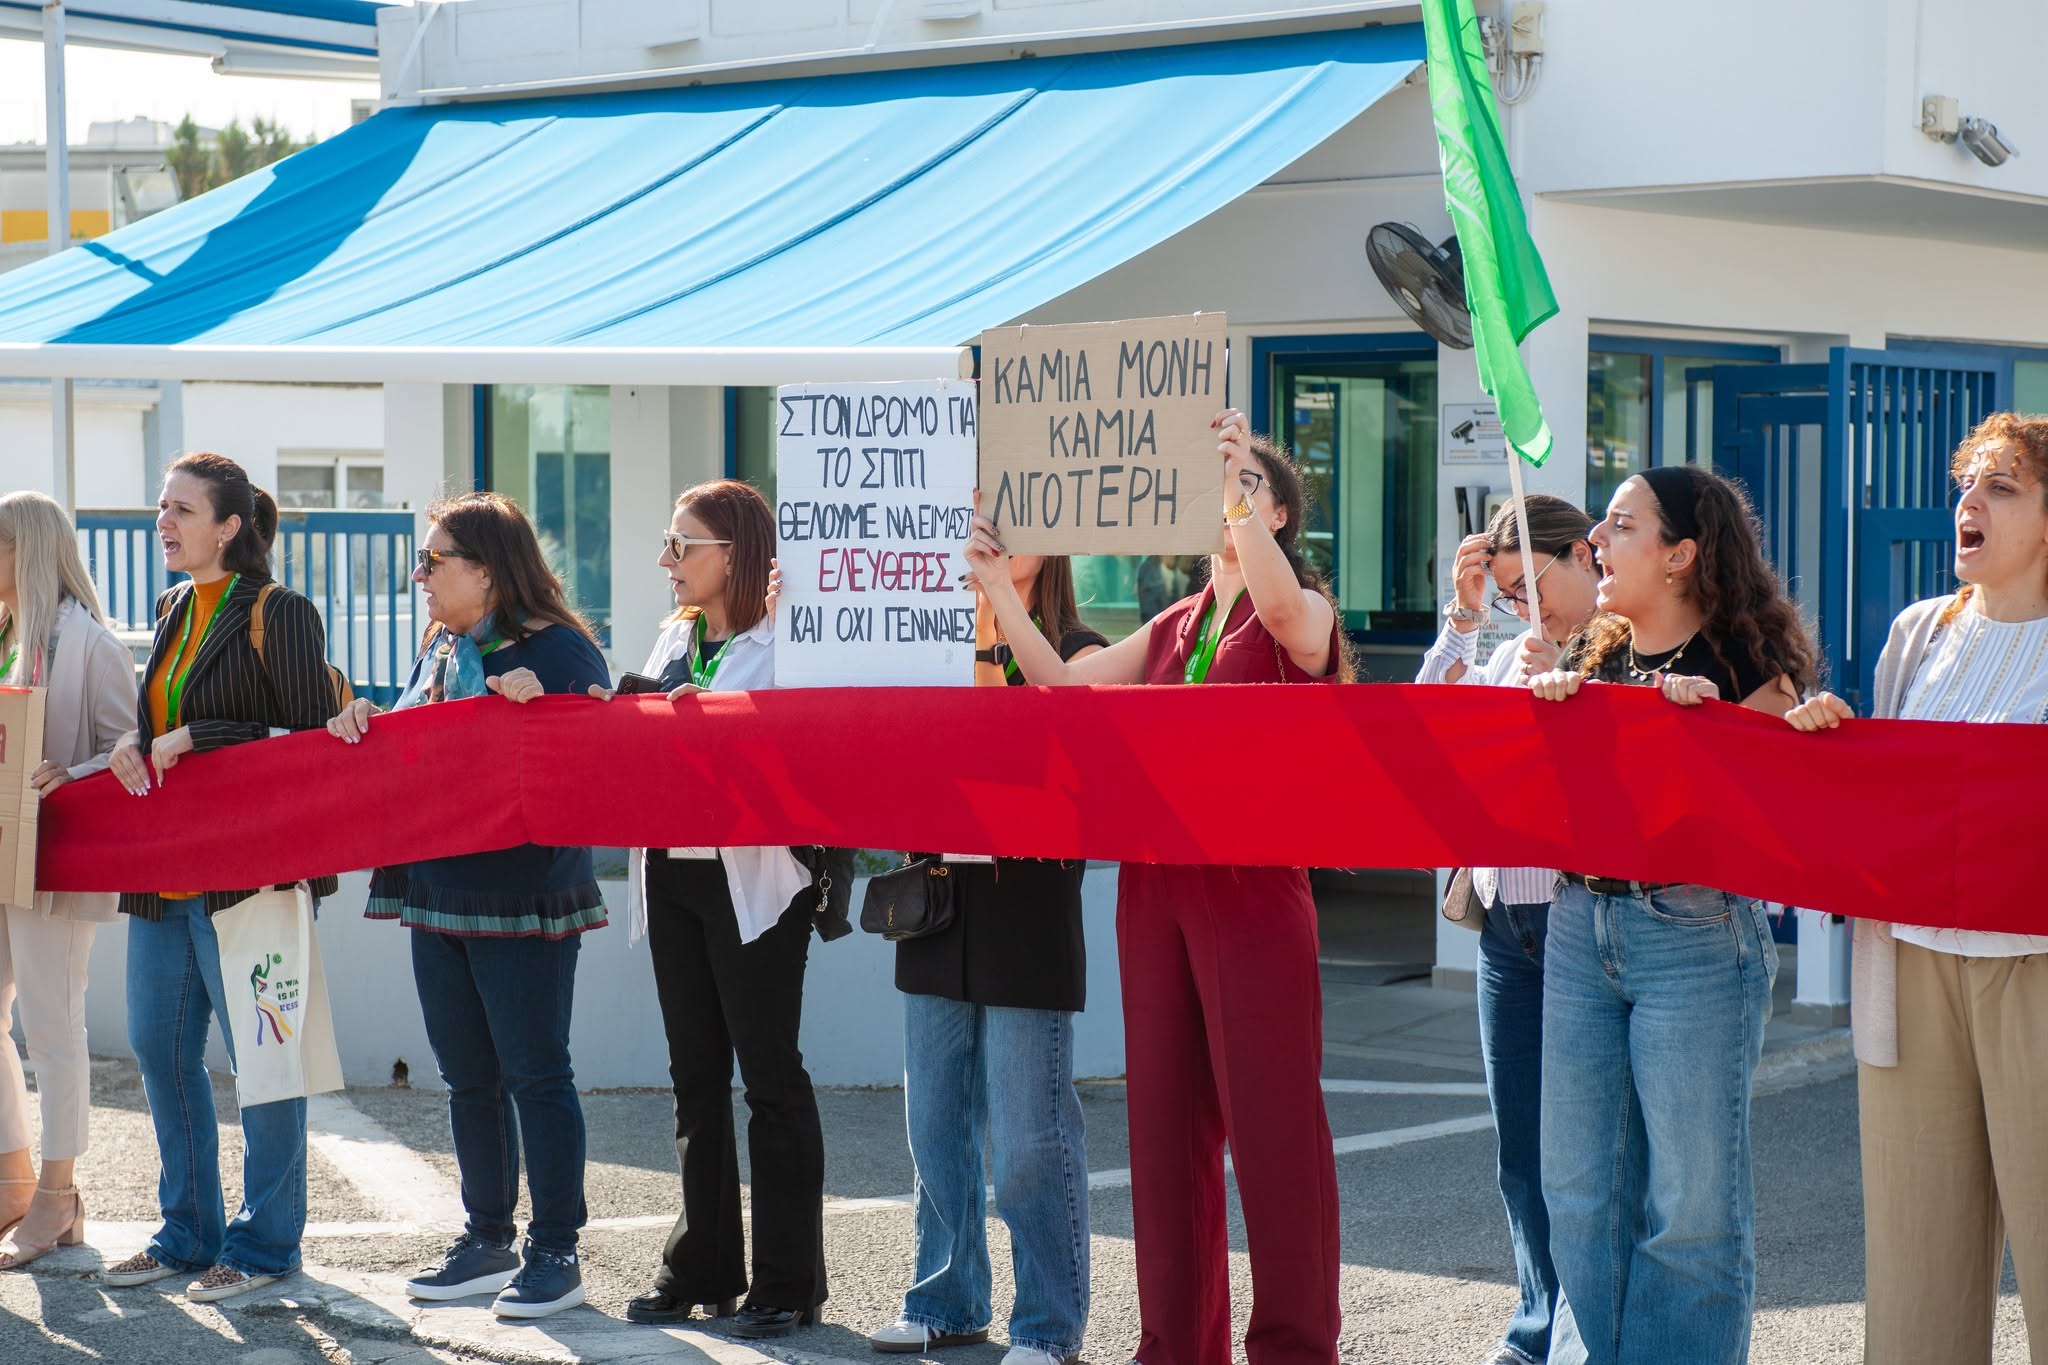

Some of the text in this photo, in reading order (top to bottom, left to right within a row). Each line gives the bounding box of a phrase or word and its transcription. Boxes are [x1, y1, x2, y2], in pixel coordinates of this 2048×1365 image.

[995, 337, 1212, 404] ΚΑΜΙΑ ΜΟΝΗ
[780, 394, 976, 439] ΣΤΟΝ ΔΡΟΜΟ ΓΙΑ
[1050, 408, 1157, 458] ΚΑΜΙΑ
[817, 447, 926, 489] ΤΟ ΣΠΙΤΙ
[992, 465, 1177, 529] ΛΙΓΟΤΕΡΗ
[779, 501, 974, 541] ΘΕΛΟΥΜΕ ΝΑ ΕΙΜΑΣΤ
[819, 548, 953, 592] ΕΛΕΥΘΕΡΕΣ
[790, 605, 976, 643] ΚΑΙ ΟΧΙ ΓΕΝΝΑΙΕΣ
